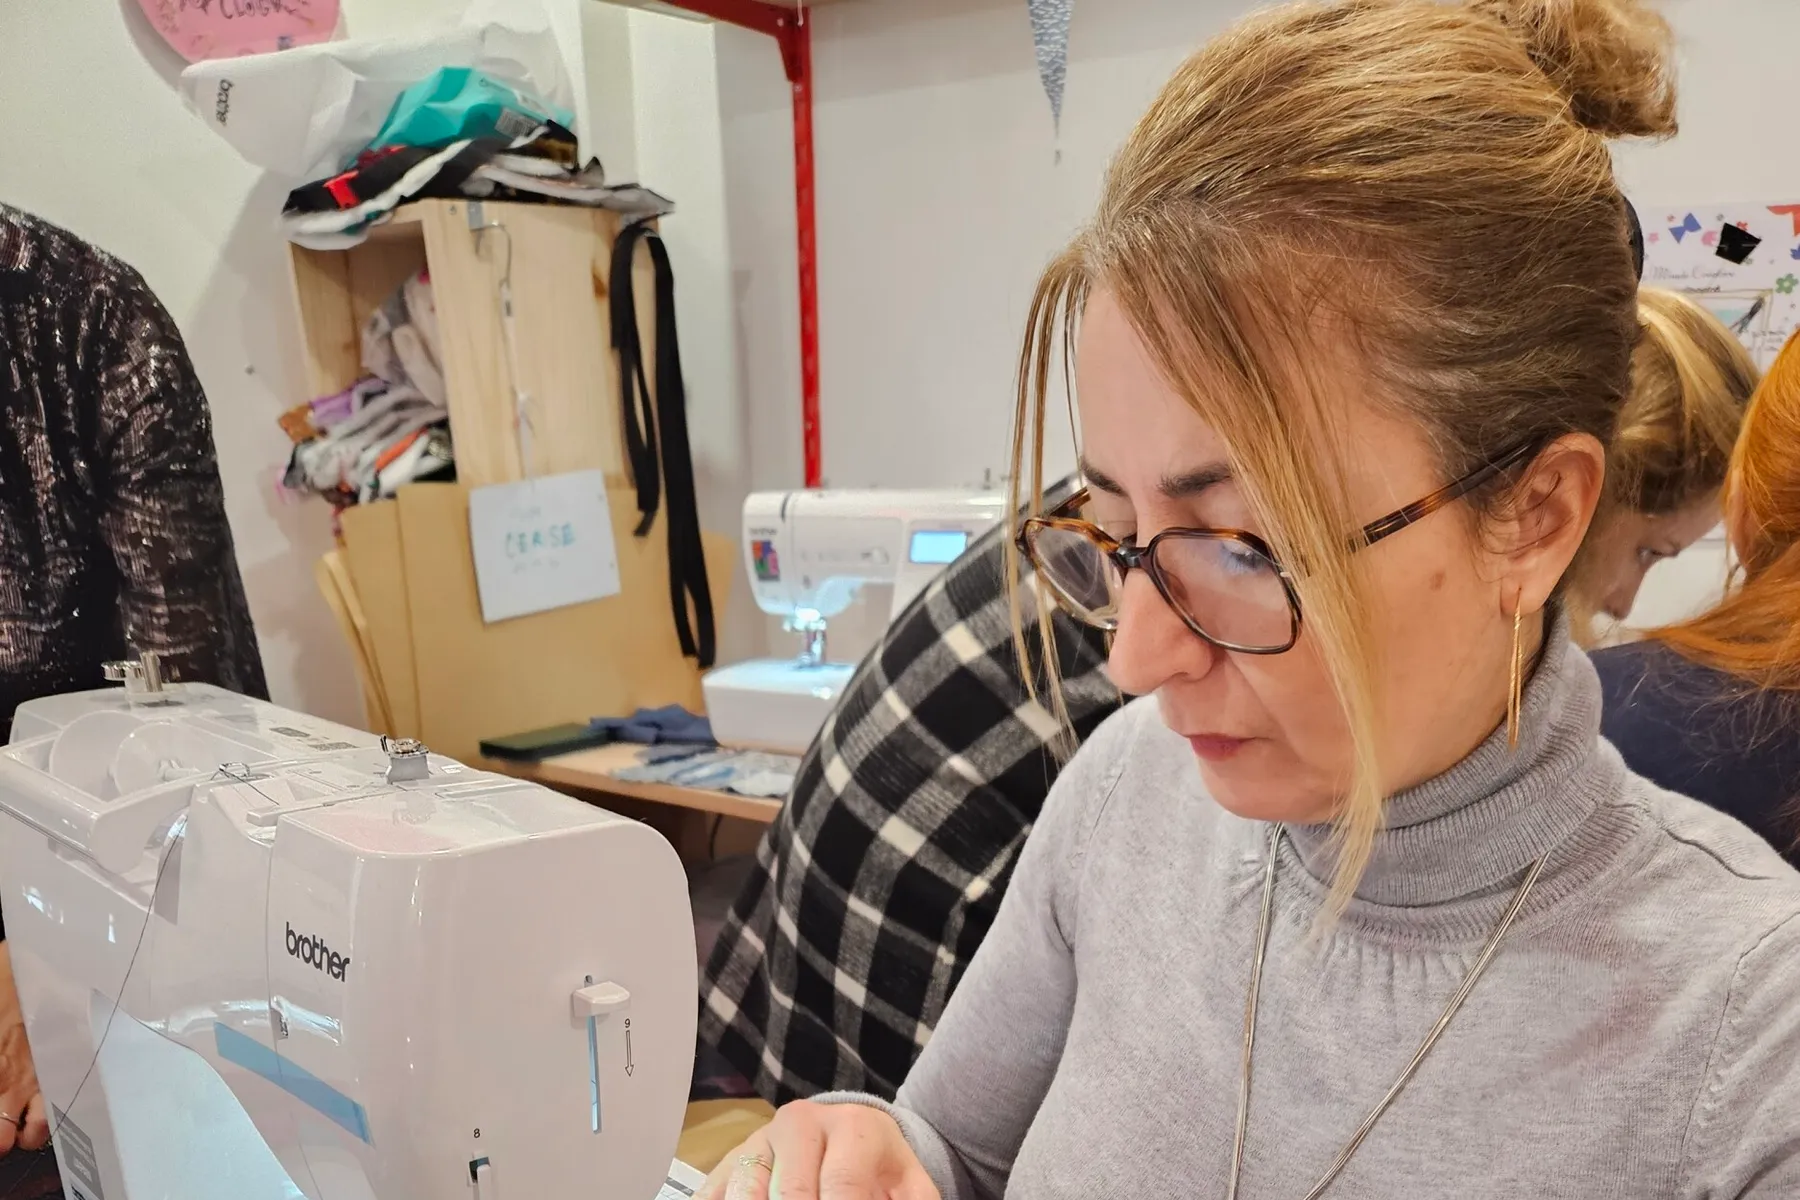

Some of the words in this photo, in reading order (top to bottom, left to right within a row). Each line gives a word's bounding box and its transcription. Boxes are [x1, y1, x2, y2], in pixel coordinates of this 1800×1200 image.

[286, 921, 350, 982] brother
[624, 1018, 631, 1029] 9
[473, 1128, 480, 1138] 8
